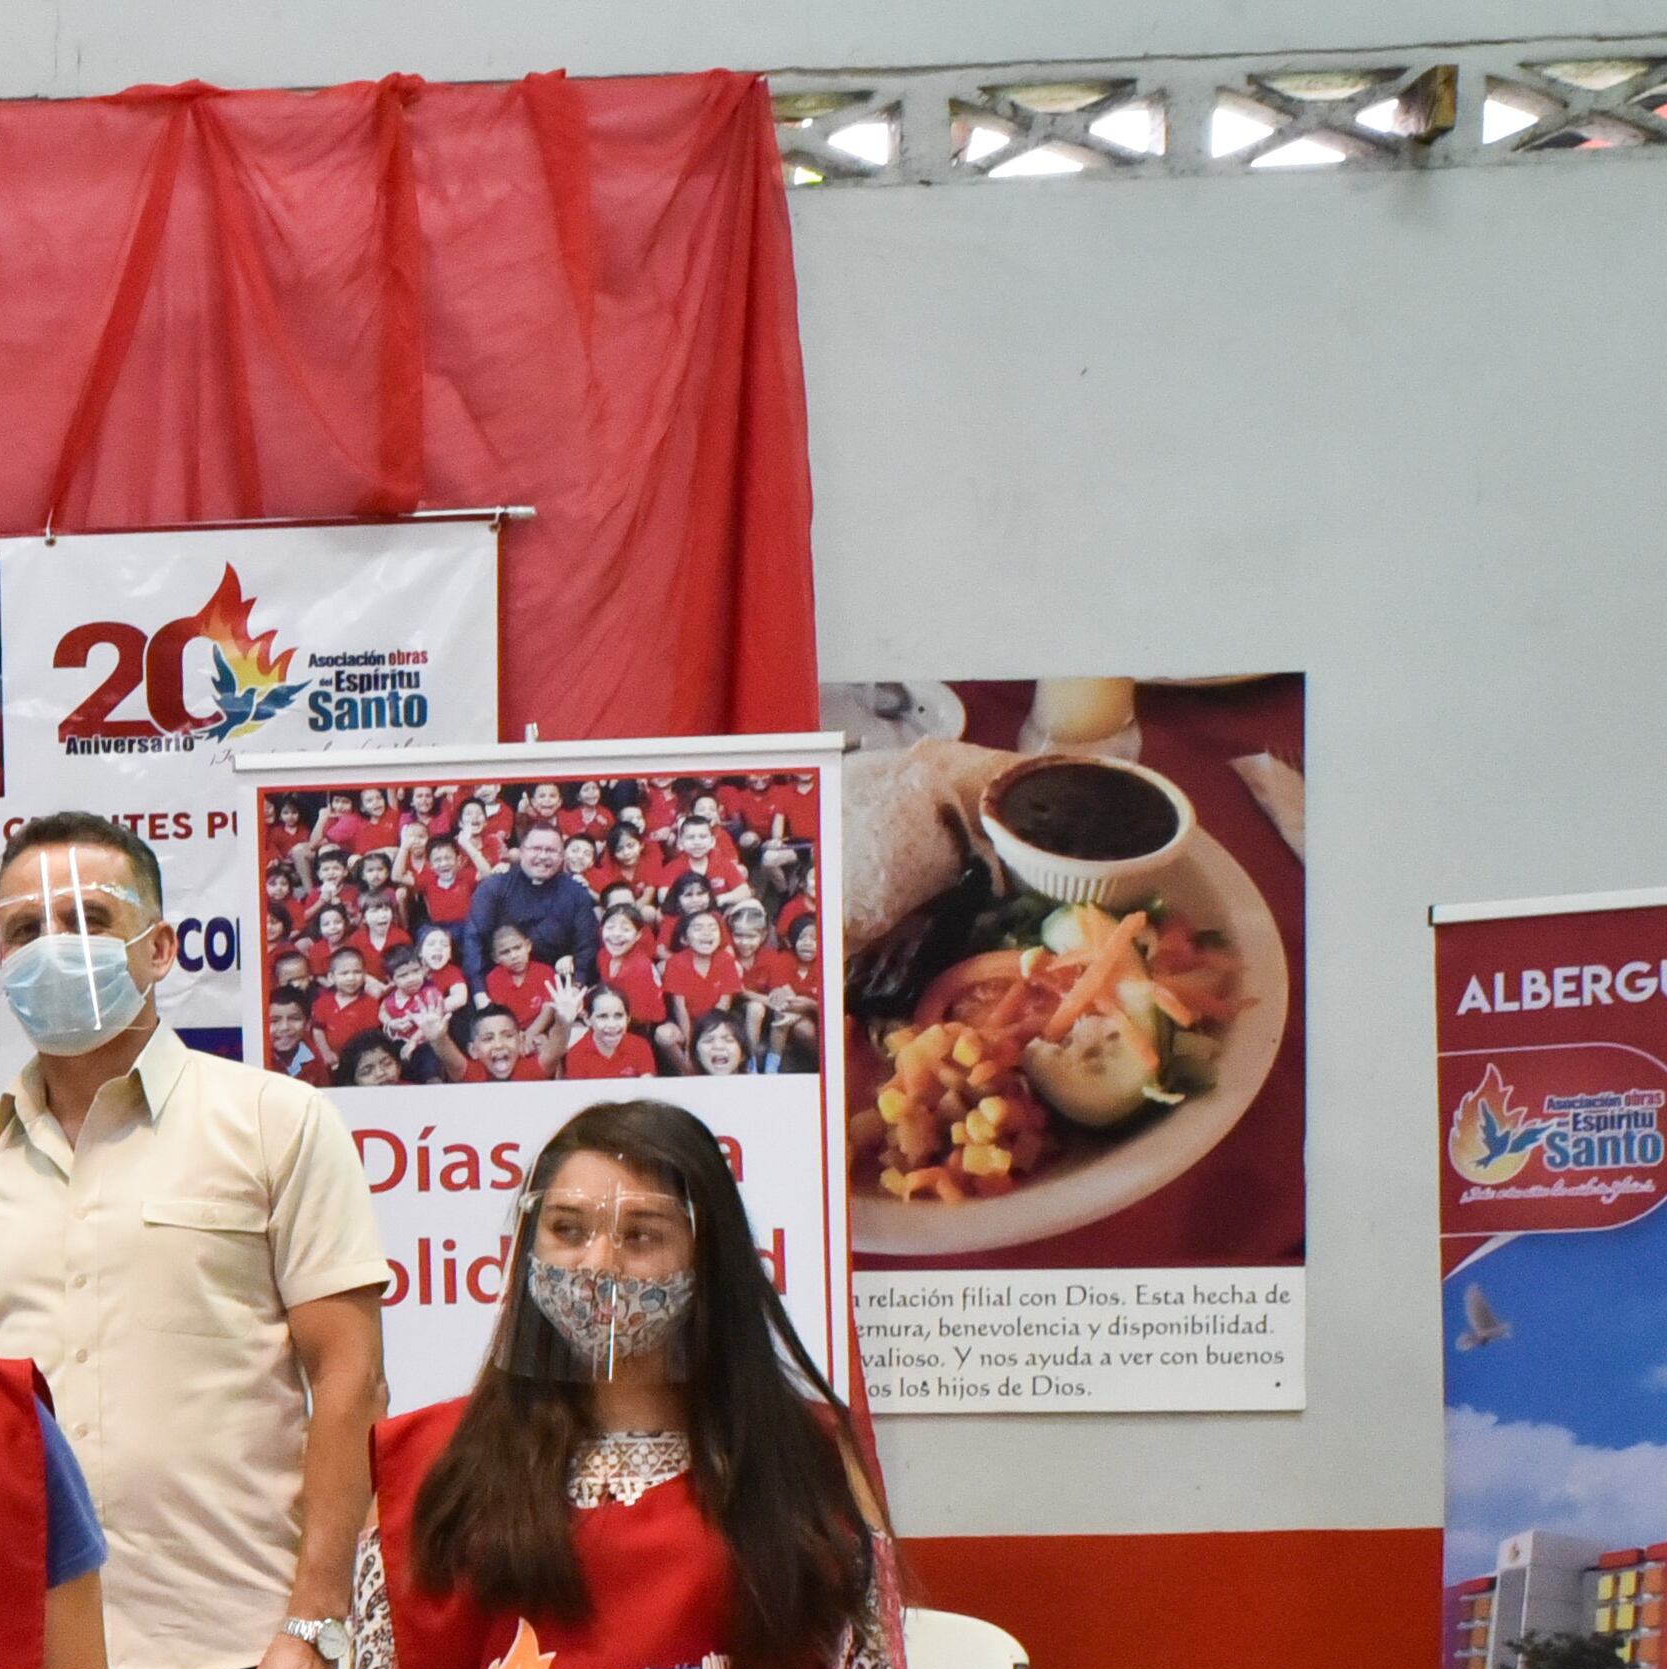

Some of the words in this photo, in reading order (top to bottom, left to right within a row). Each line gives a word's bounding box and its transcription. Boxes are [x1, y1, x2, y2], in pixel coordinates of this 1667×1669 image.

[308, 651, 384, 667] Asociación
[388, 649, 428, 665] obras
[334, 668, 420, 693] Espíritu
[307, 689, 427, 731] Santo
[65, 734, 194, 756] Aniversario
[1456, 960, 1667, 1015] ALBERG
[1571, 1108, 1655, 1132] Espíritu
[351, 1125, 523, 1194] Días
[1544, 1130, 1663, 1171] Santo
[868, 1286, 953, 1308] relación
[960, 1285, 1010, 1311] filial
[1019, 1291, 1056, 1306] con
[1065, 1284, 1125, 1306] Dios.
[1135, 1283, 1185, 1305] Esta
[1192, 1284, 1256, 1304] hecha
[1264, 1283, 1291, 1304] de
[938, 1316, 1080, 1338] benevolencia
[1087, 1323, 1101, 1341] y
[1107, 1314, 1274, 1339] disponibilidad.
[953, 1345, 971, 1371] Y
[979, 1352, 1017, 1367] nos
[1024, 1345, 1092, 1372] ayuda
[1099, 1352, 1112, 1365] a
[1119, 1351, 1153, 1365] ver
[1159, 1351, 1198, 1365] con
[1205, 1344, 1285, 1365] buenos
[899, 1377, 930, 1398] los
[937, 1375, 989, 1401] hijos
[997, 1376, 1023, 1397] de
[1030, 1374, 1092, 1397] Dios.
